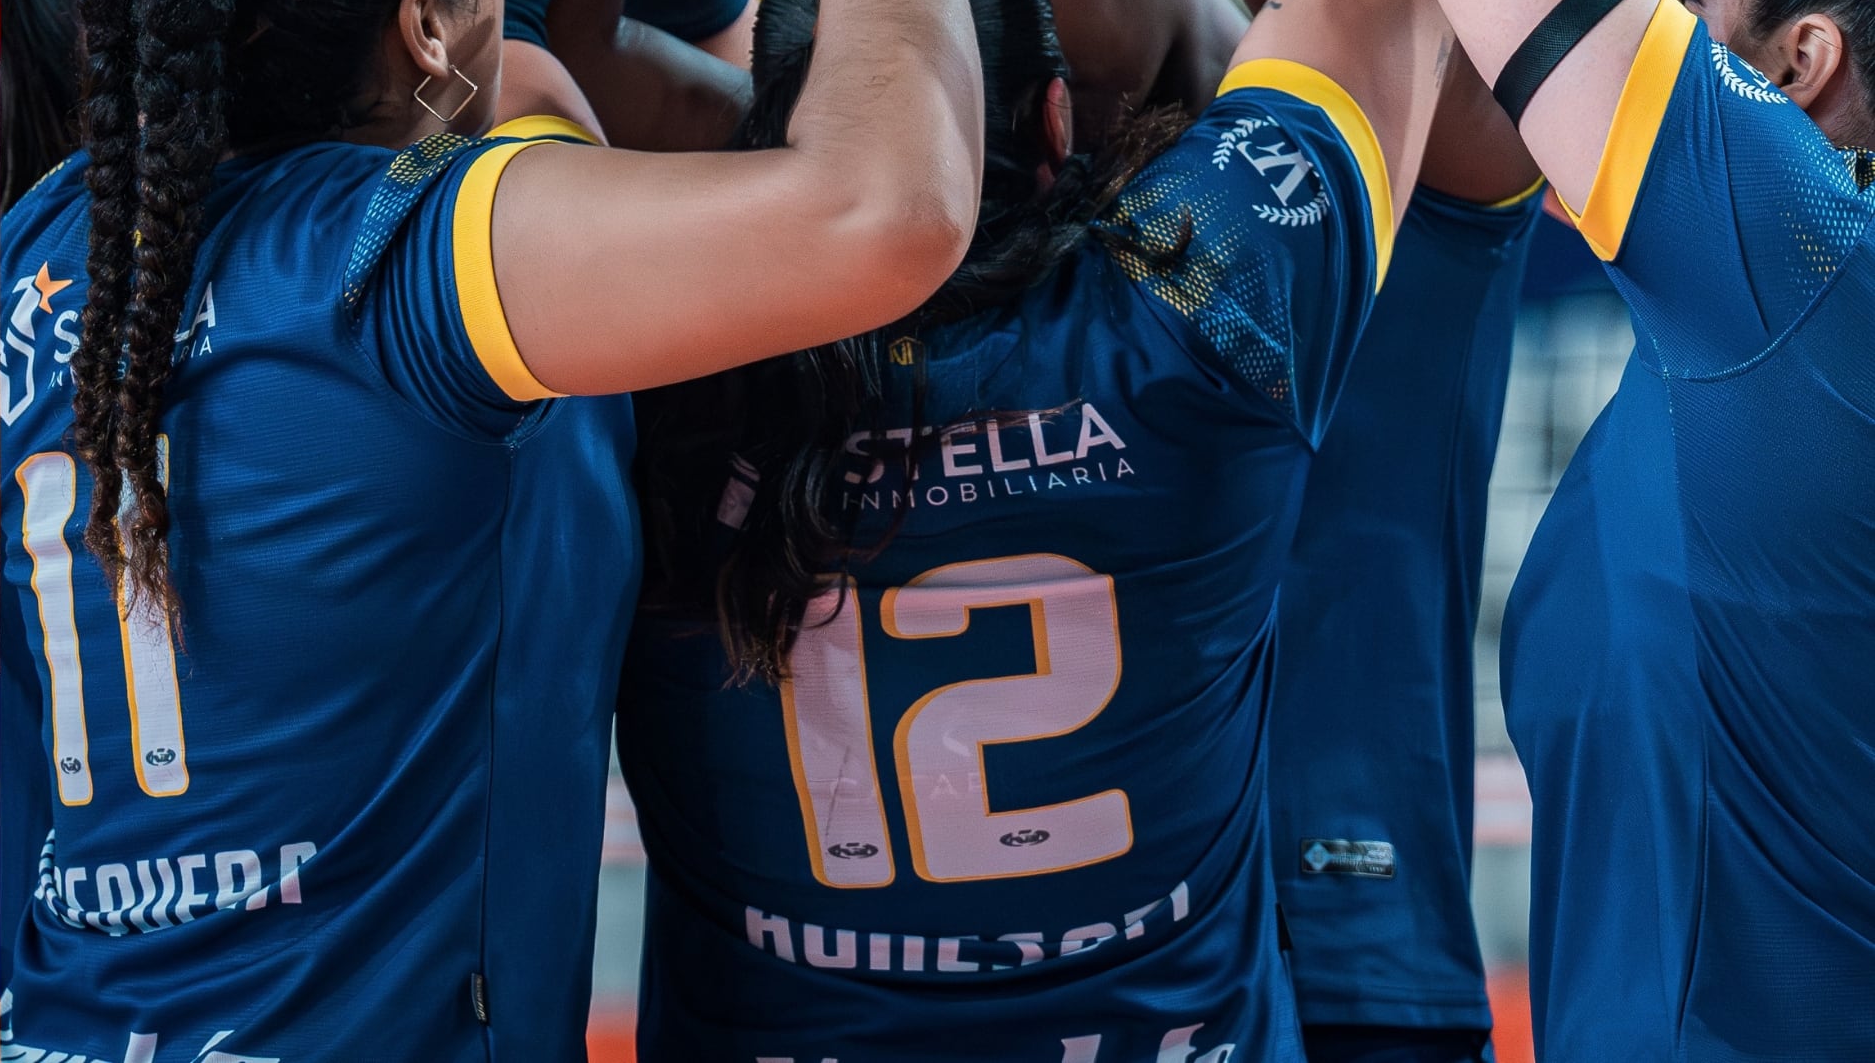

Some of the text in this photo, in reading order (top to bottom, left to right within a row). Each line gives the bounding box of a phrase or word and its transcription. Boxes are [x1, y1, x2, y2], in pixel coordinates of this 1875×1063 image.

[841, 457, 1136, 511] INMOBILIARIA
[844, 401, 1128, 479] STELLA
[14, 433, 190, 806] 11
[779, 551, 1135, 889] 12
